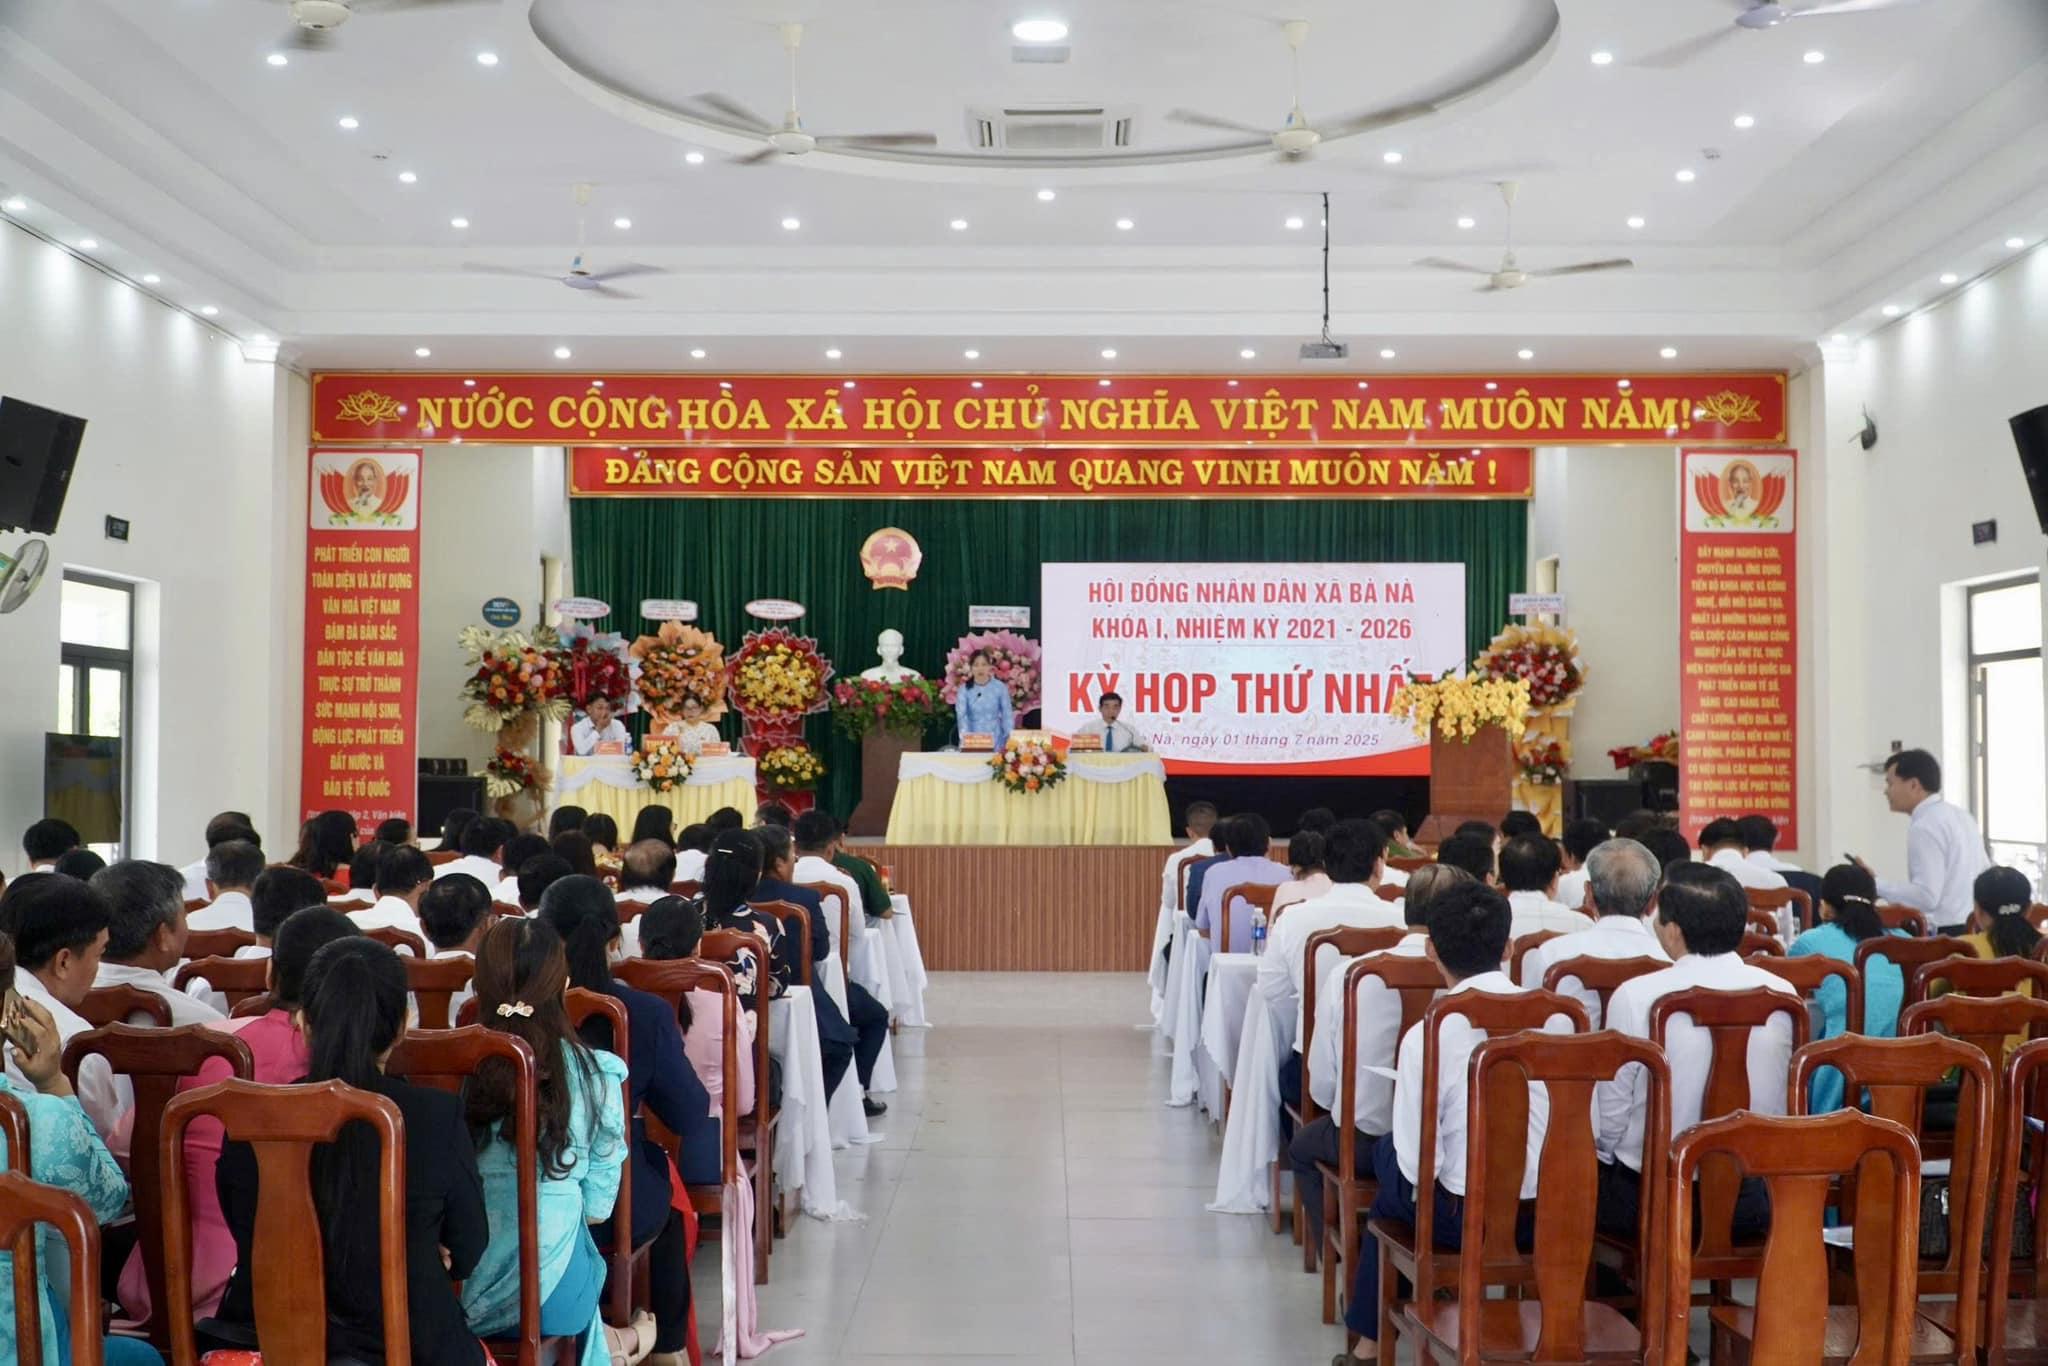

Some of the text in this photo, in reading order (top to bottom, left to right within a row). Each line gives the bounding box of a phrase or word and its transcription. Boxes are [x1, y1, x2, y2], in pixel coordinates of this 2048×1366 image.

[417, 385, 534, 429] NƯỚC
[549, 387, 669, 438] CỘNG
[677, 389, 771, 430] HÒA
[785, 388, 848, 430] XÃ
[863, 387, 941, 439] HỘI
[953, 384, 1045, 430] CHỦ
[1060, 389, 1200, 430] NGHĨA
[1210, 388, 1319, 439] VIỆT
[1331, 398, 1427, 430] NAM
[1440, 388, 1567, 430] MUÔN
[605, 449, 701, 484] ĐẢNG
[710, 452, 803, 490] CỘNG
[814, 450, 882, 485] SẢN
[891, 453, 973, 490] VIỆT
[982, 460, 1056, 485] NAM
[1069, 458, 1185, 491] QUANG
[1192, 460, 1281, 485] VINH
[1289, 452, 1391, 485] MUÔN
[1400, 452, 1475, 485] NĂM
[1088, 578, 1123, 608] HỘI
[1196, 578, 1256, 603] NHÂN
[1263, 578, 1307, 603] DÂN
[1350, 578, 1378, 603] BÀ
[1385, 578, 1415, 603] NÀ
[1092, 613, 1149, 639] KHÓA
[1176, 613, 1246, 643] NHIỆM
[1253, 614, 1280, 639] KỲ
[1287, 618, 1336, 639] 2021
[1360, 618, 1412, 639] 2026
[1069, 658, 1433, 723] KỲ HỌP THỨ NHẤ
[1223, 734, 1239, 745] 01
[1344, 734, 1379, 746] 2025
